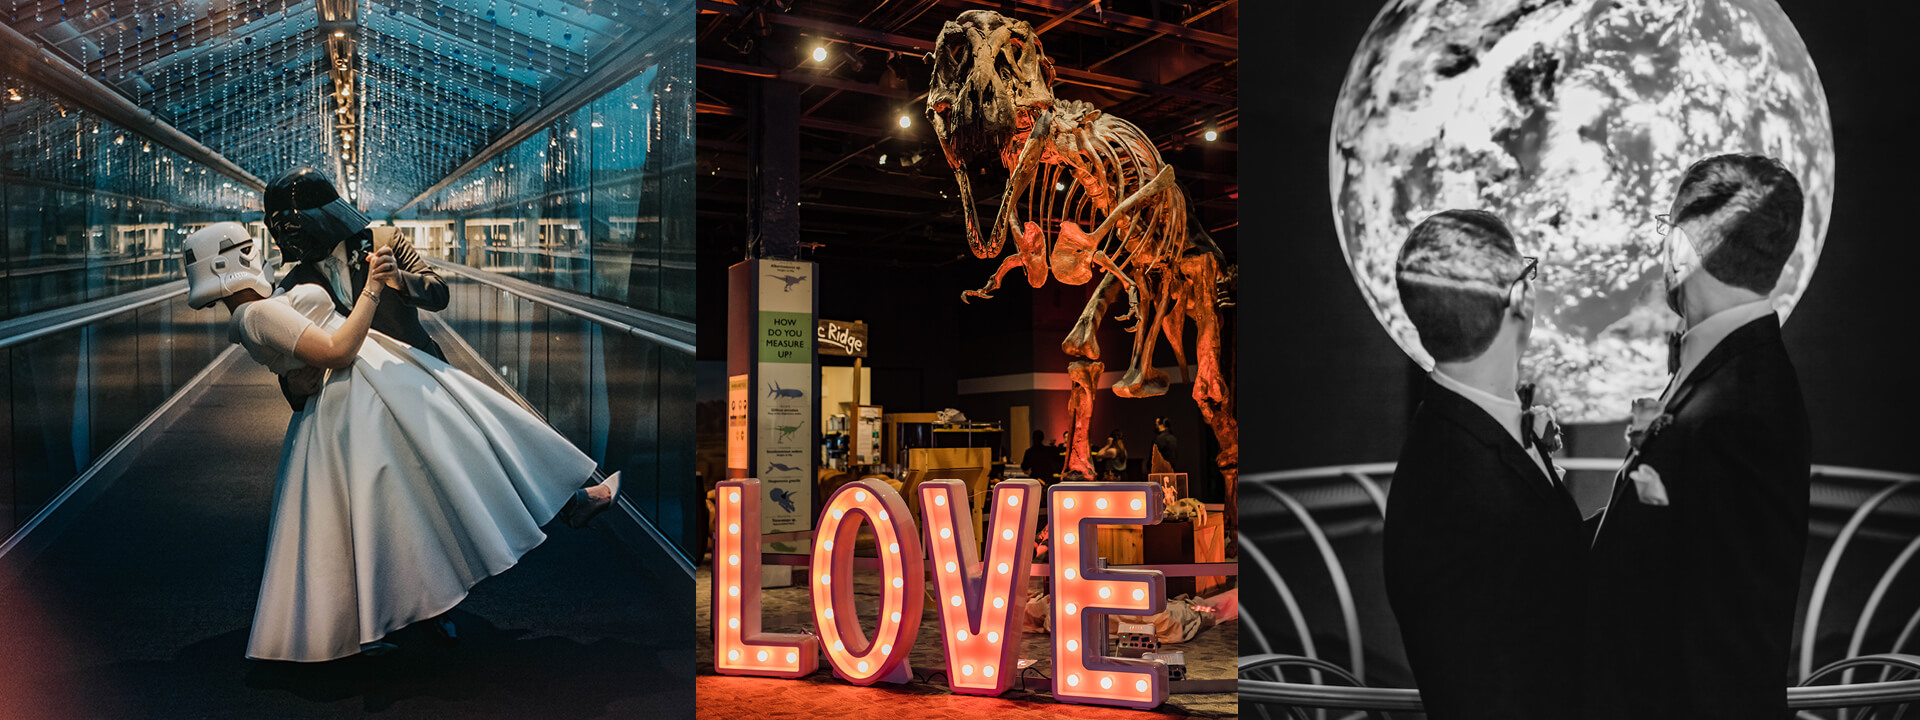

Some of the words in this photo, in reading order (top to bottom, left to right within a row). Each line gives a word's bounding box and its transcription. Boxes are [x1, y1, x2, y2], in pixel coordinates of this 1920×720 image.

[774, 318, 797, 327] HOW
[768, 329, 782, 337] DO
[784, 329, 803, 338] YOU
[828, 322, 863, 355] Ridge
[766, 339, 805, 349] MEASURE
[778, 350, 792, 359] UP?
[714, 478, 1170, 709] LOVE
